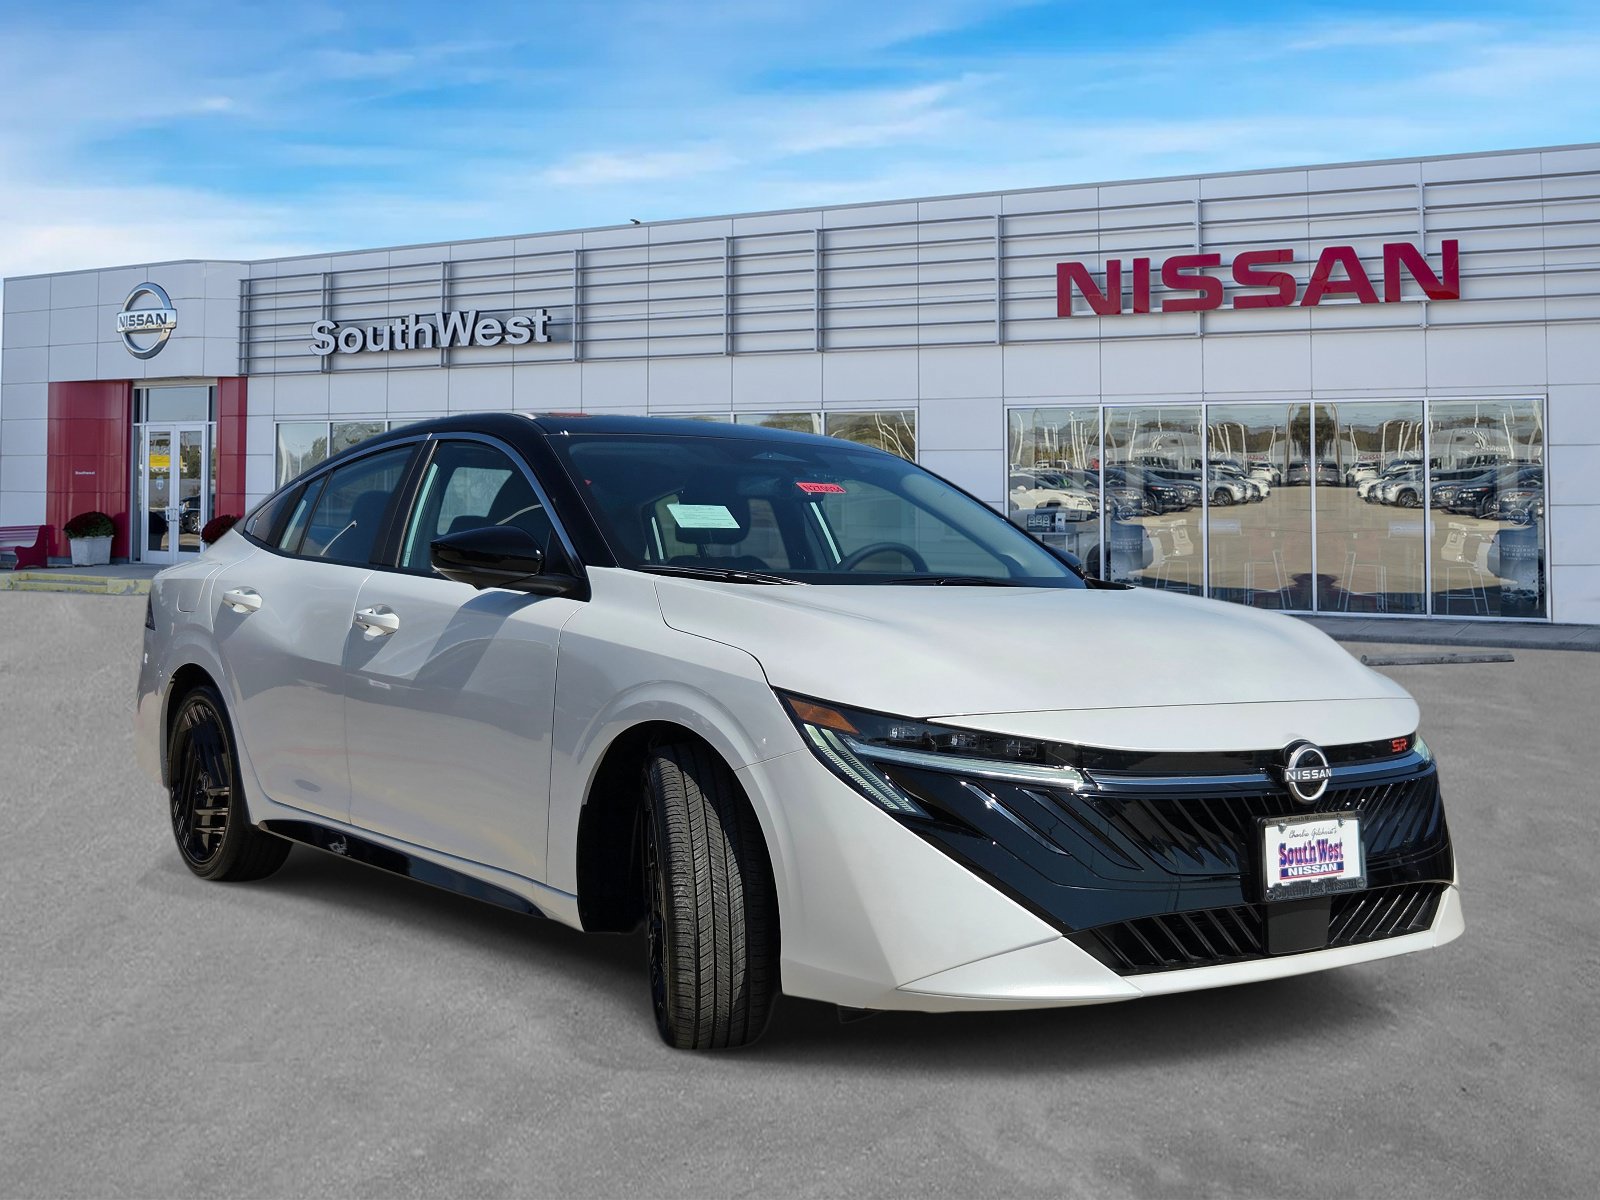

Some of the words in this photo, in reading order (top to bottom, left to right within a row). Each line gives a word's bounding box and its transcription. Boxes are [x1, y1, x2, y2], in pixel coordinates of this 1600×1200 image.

[1056, 239, 1461, 317] NISSAN
[117, 311, 169, 330] NISSAN
[310, 308, 551, 356] SouthWest
[1391, 739, 1407, 752] SR
[1285, 767, 1332, 780] NISSAN
[1288, 863, 1338, 876] NISSAN
